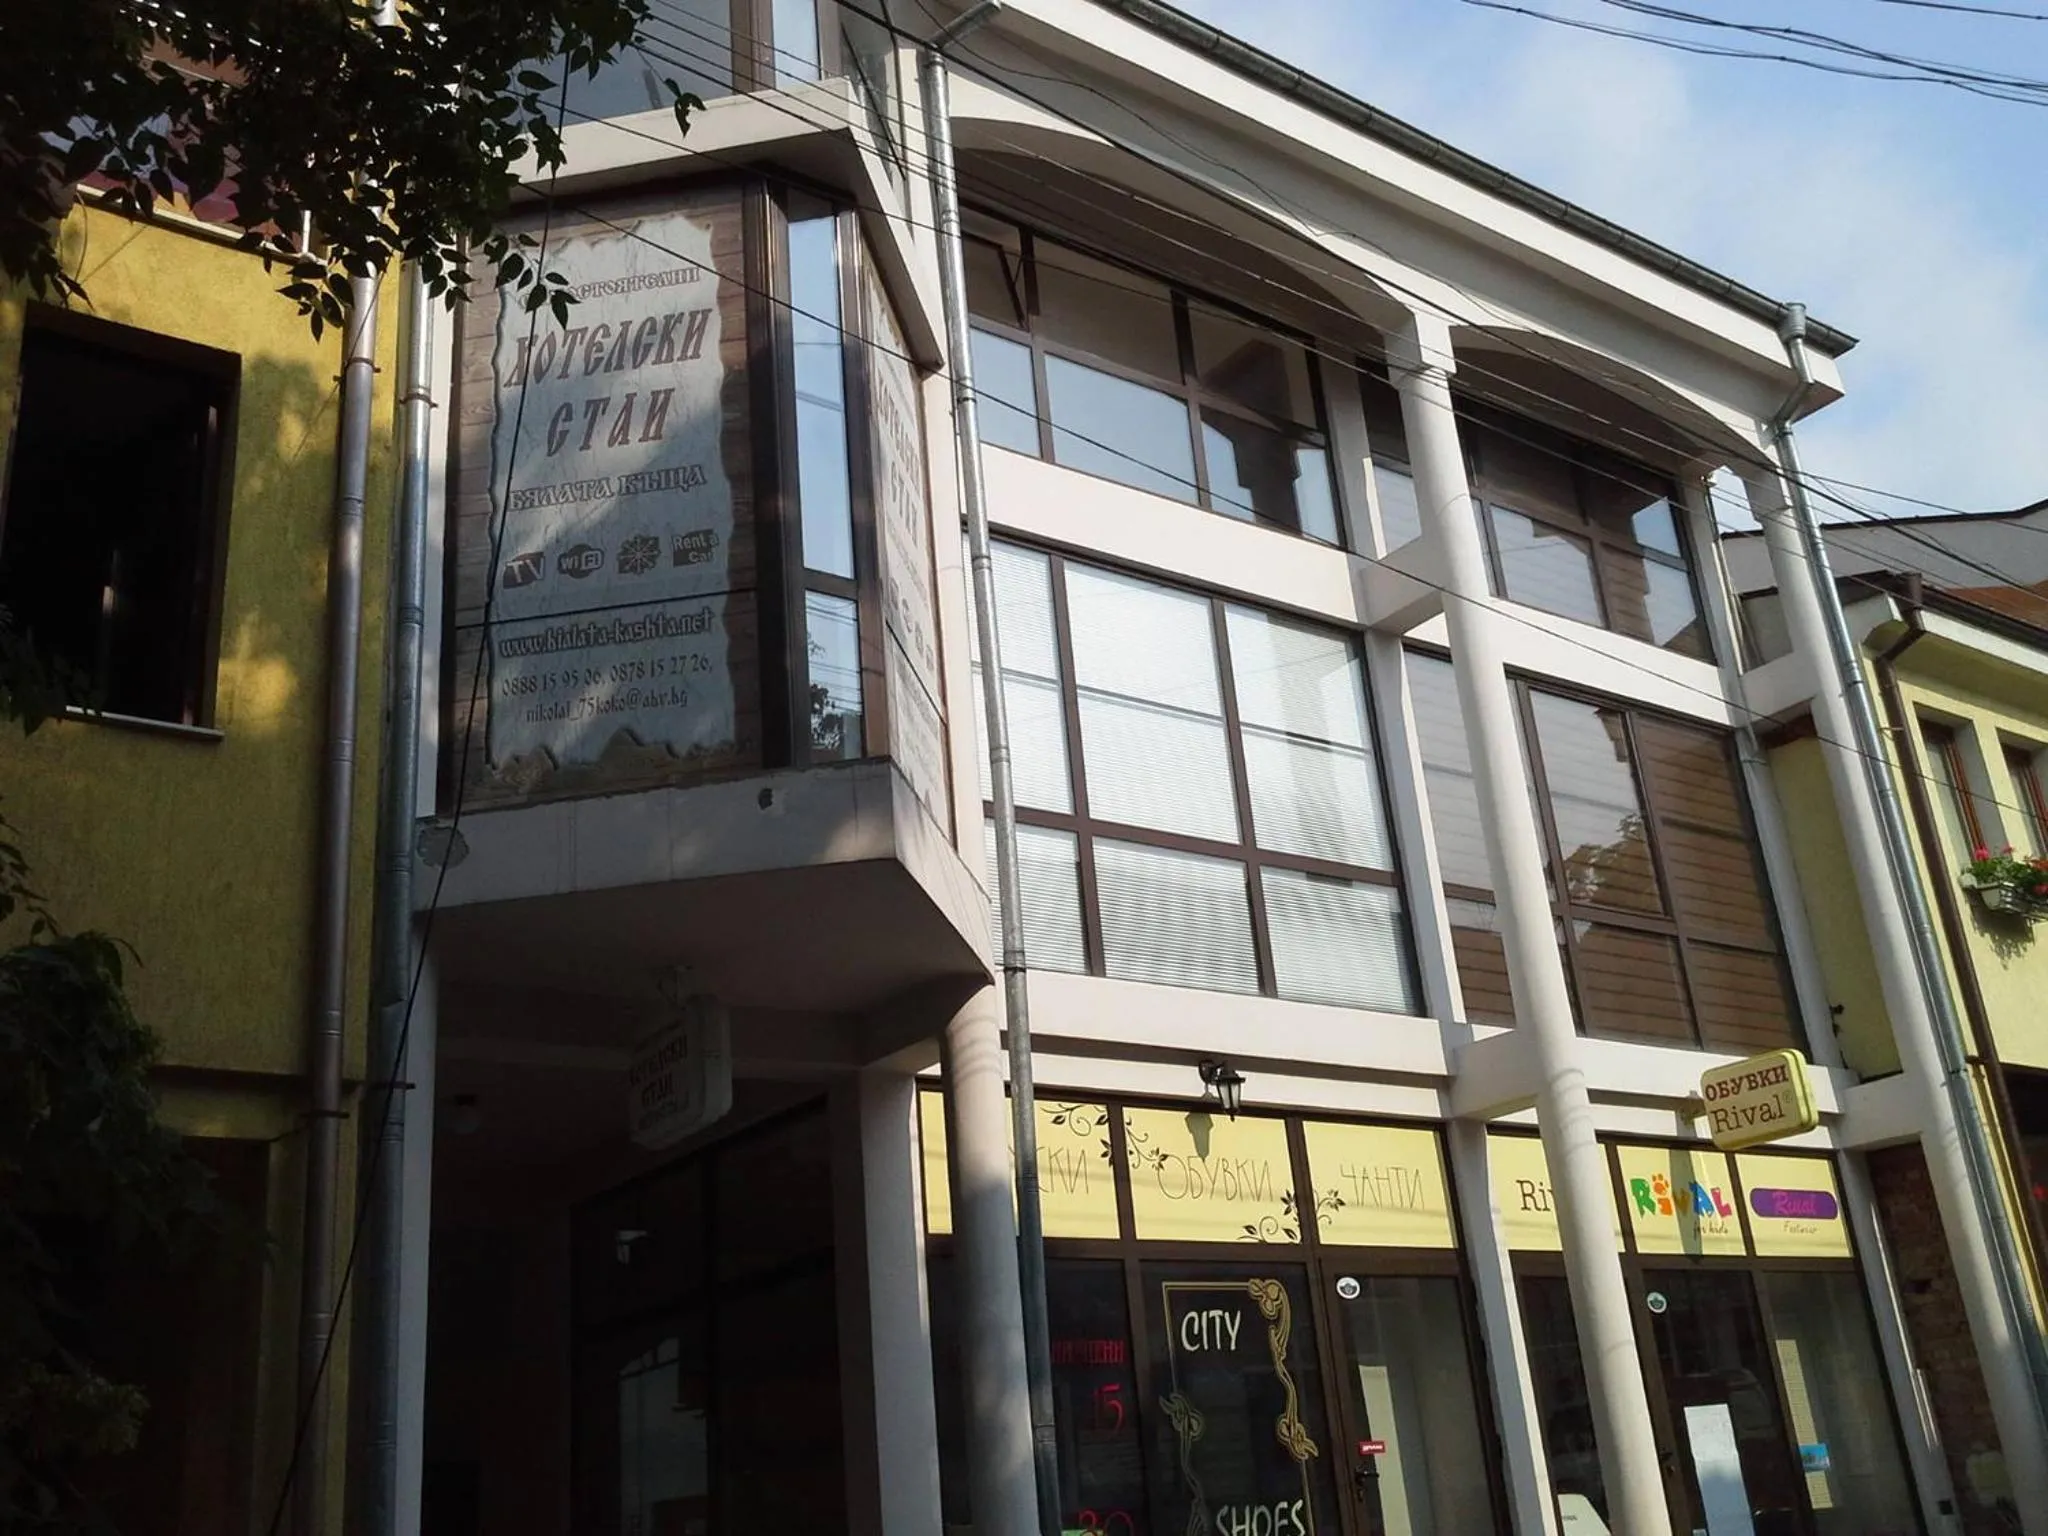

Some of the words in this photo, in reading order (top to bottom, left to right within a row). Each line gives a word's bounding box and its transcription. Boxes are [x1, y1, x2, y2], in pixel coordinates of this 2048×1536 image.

[504, 308, 712, 387] ХОТЕЛСКИ
[547, 388, 675, 457] СТАИ
[508, 477, 615, 511] БЯЛАТА
[617, 464, 707, 493] КЪЩА
[672, 533, 706, 550] Rent
[688, 550, 714, 563] Car
[505, 554, 545, 585] TV
[1705, 1064, 1789, 1101] ОБУВКИ
[1158, 1154, 1273, 1202] ОБУВКИ
[1340, 1164, 1425, 1210] ЧАНТИ
[1516, 1179, 1553, 1212] Ri
[1181, 1310, 1241, 1351] CITY
[1216, 1500, 1306, 1536] SHOES
